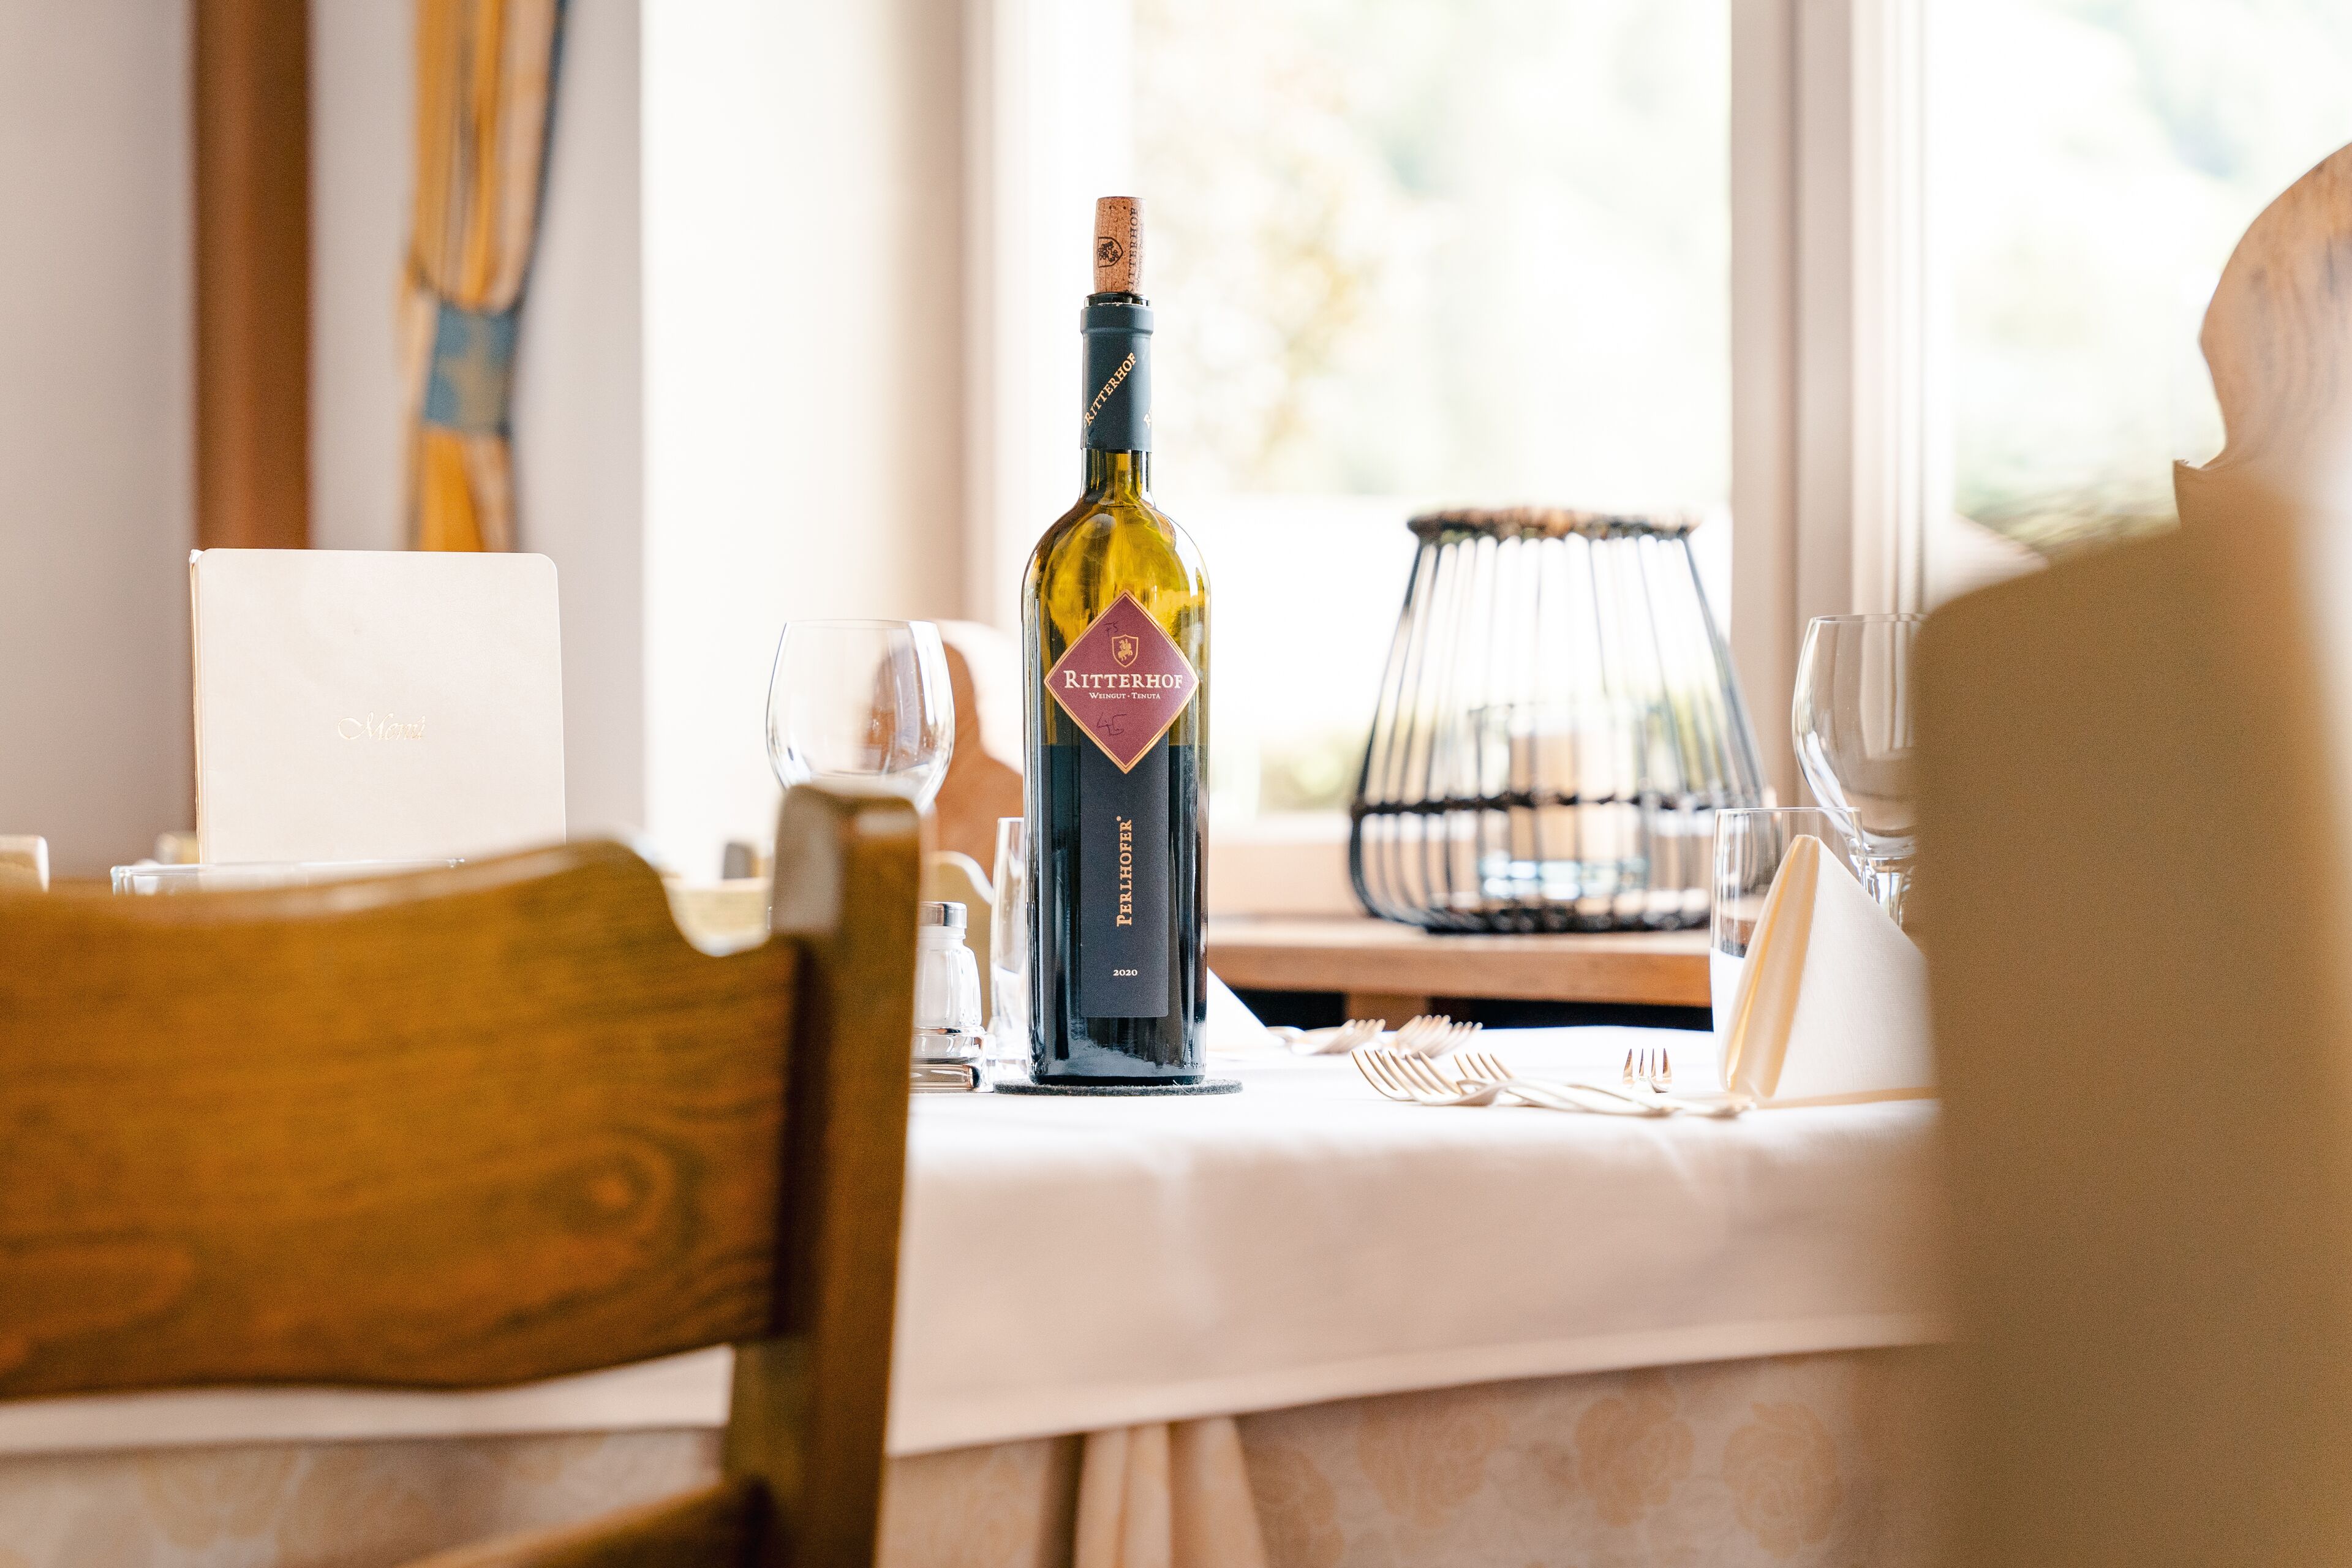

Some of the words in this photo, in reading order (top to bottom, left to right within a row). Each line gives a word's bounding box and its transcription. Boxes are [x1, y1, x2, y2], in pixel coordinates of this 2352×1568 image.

[1084, 352, 1137, 427] RITTERHOF
[1063, 669, 1184, 689] RITTERHOF
[1112, 968, 1138, 977] 2020
